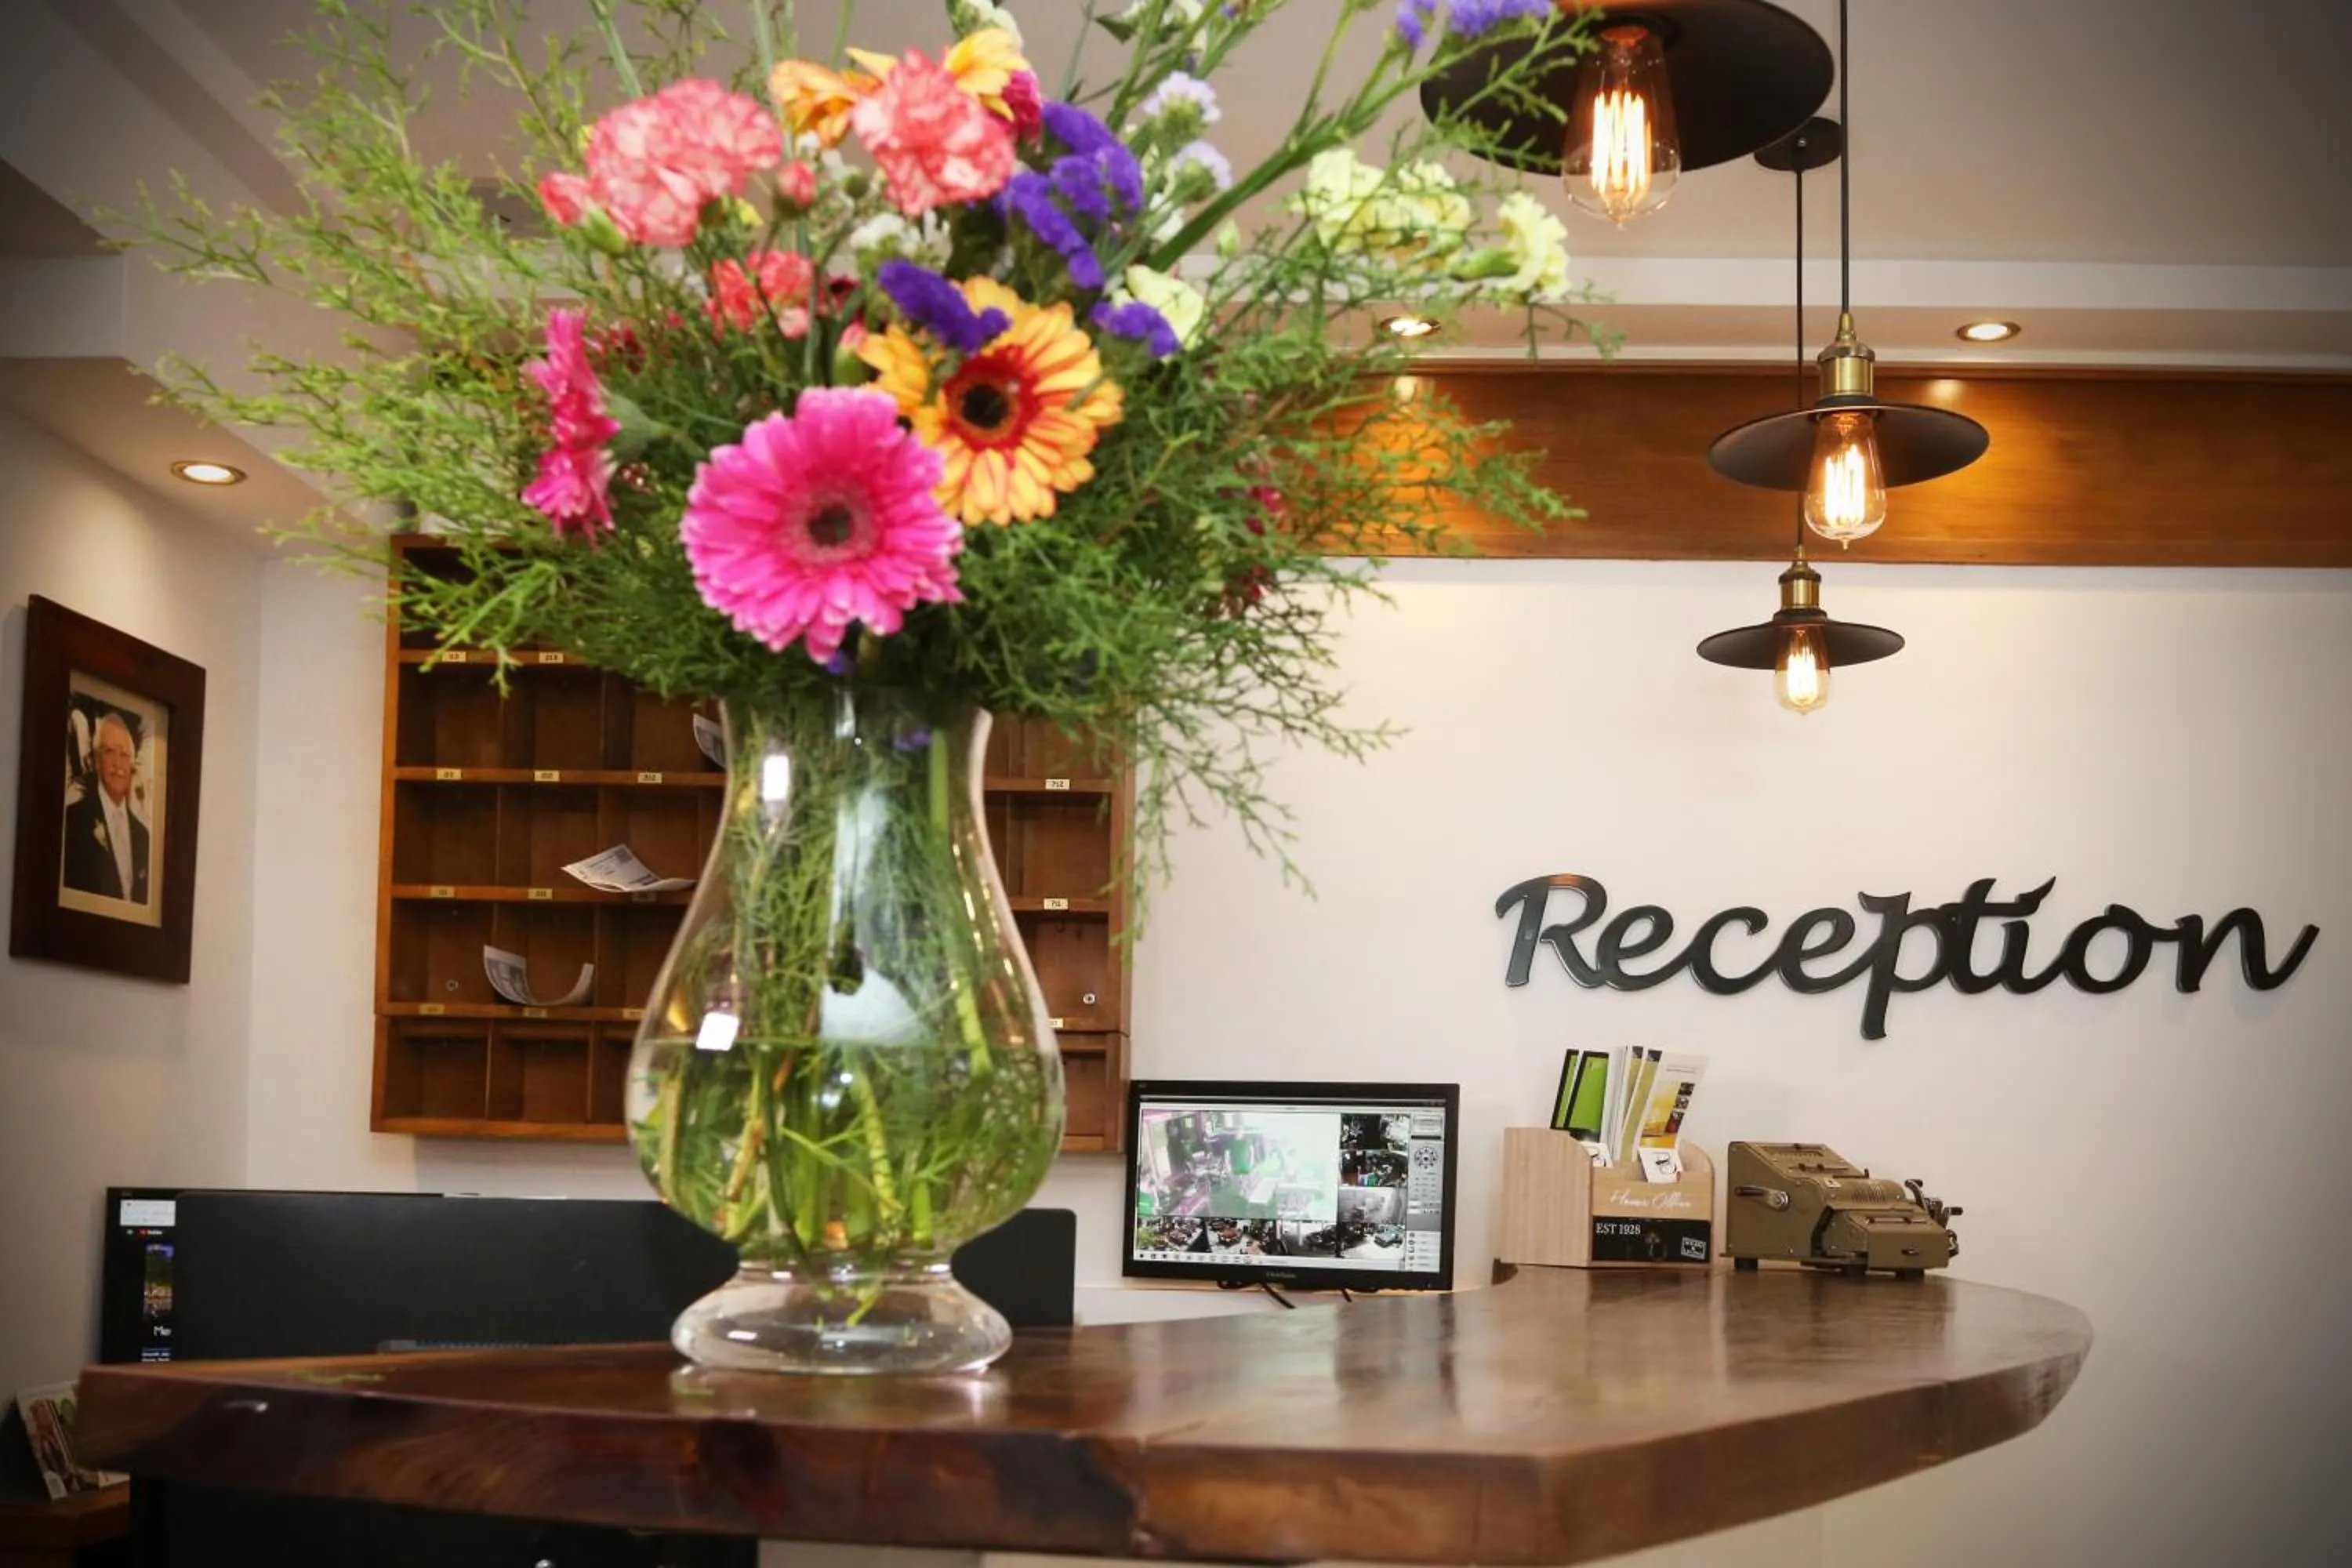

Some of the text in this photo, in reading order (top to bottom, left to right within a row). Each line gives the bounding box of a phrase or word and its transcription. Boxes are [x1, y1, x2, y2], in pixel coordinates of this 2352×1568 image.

[1496, 873, 2321, 1040] Reception
[1595, 1222, 1641, 1235] EST 1928
